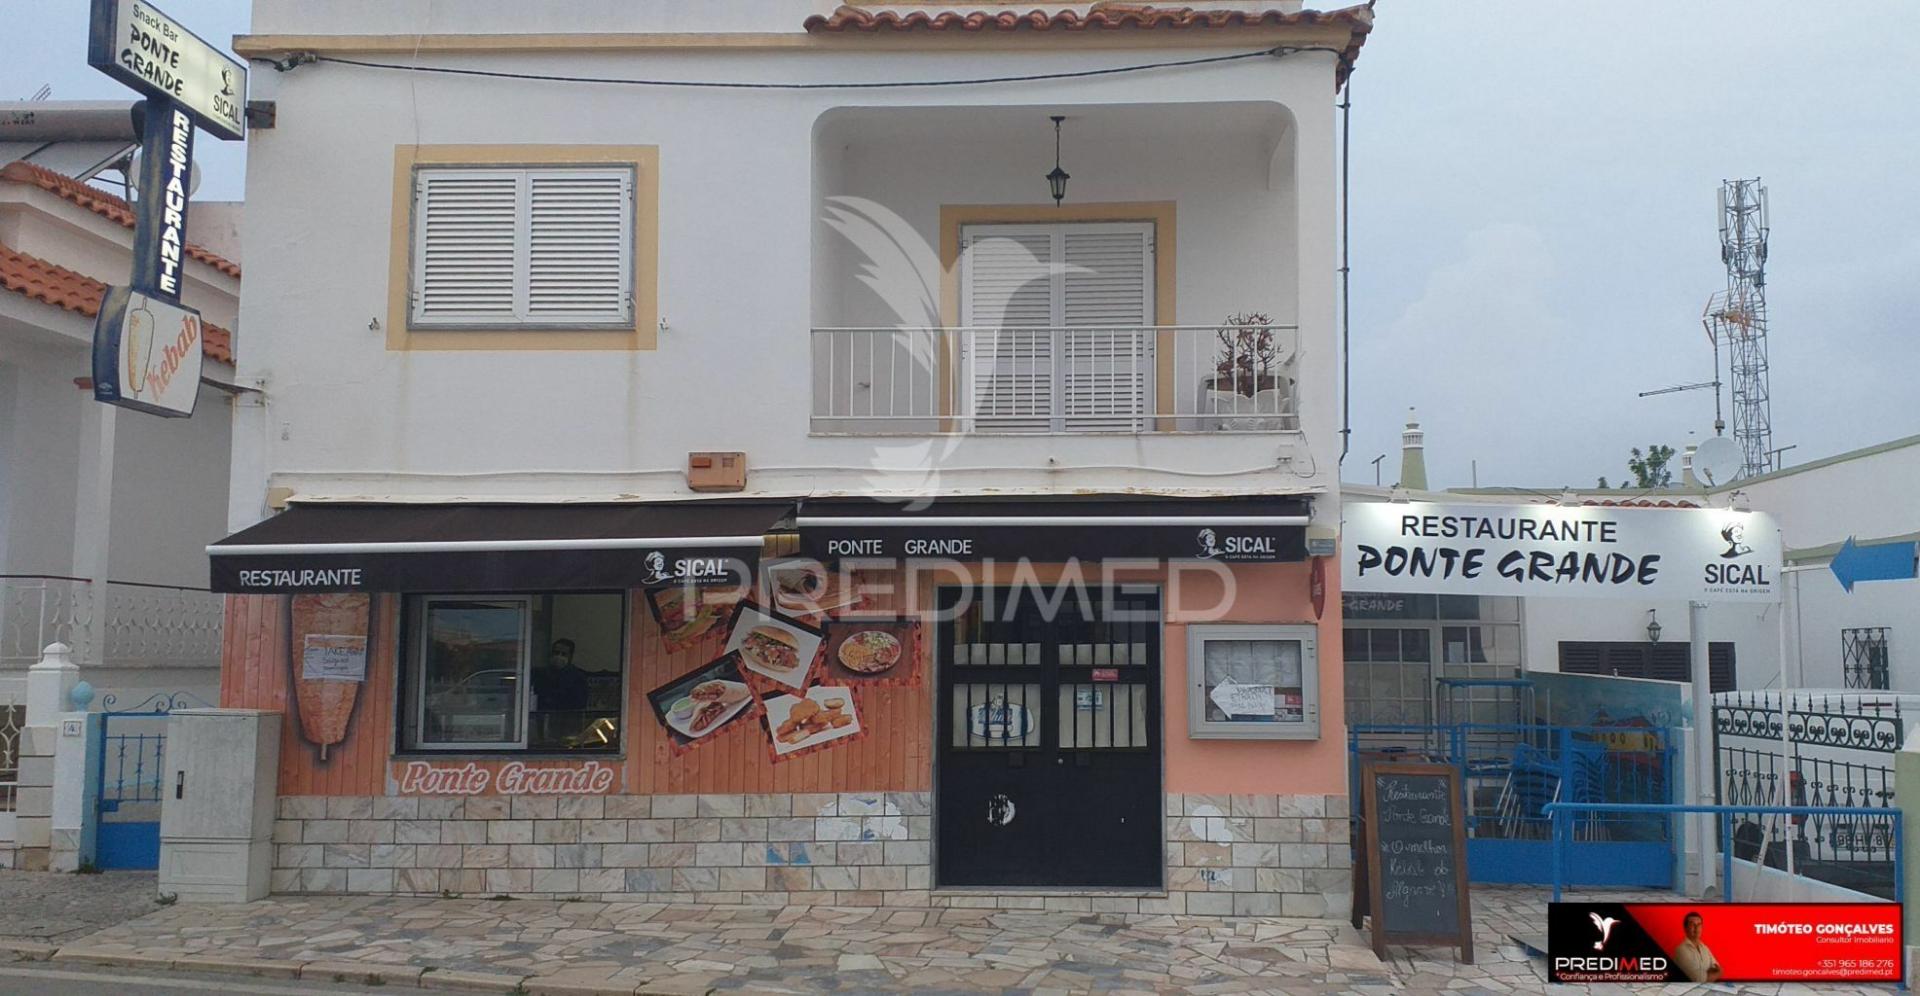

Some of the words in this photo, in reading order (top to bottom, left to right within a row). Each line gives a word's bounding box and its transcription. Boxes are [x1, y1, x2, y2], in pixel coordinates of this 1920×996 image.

[132, 4, 161, 32] Snack
[163, 24, 179, 43] Bar
[131, 23, 180, 69] PONTE
[121, 48, 184, 96] GRANDE
[213, 95, 240, 125] SICAL
[160, 109, 190, 294] RESTAURANTE
[1401, 515, 1618, 543] RESTAURANTE
[828, 539, 883, 555] PONTE
[904, 539, 973, 555] GRANDE
[1225, 537, 1276, 553] SICAL
[240, 569, 361, 586] RESTAURANTE
[674, 559, 728, 576] SICAL
[1357, 544, 1486, 580] PONTE
[1497, 550, 1661, 585] GRANDE
[1704, 563, 1770, 585] SICAL
[1350, 599, 1404, 611] GRANDE
[401, 761, 490, 794] Ponte
[496, 761, 613, 794] Grande
